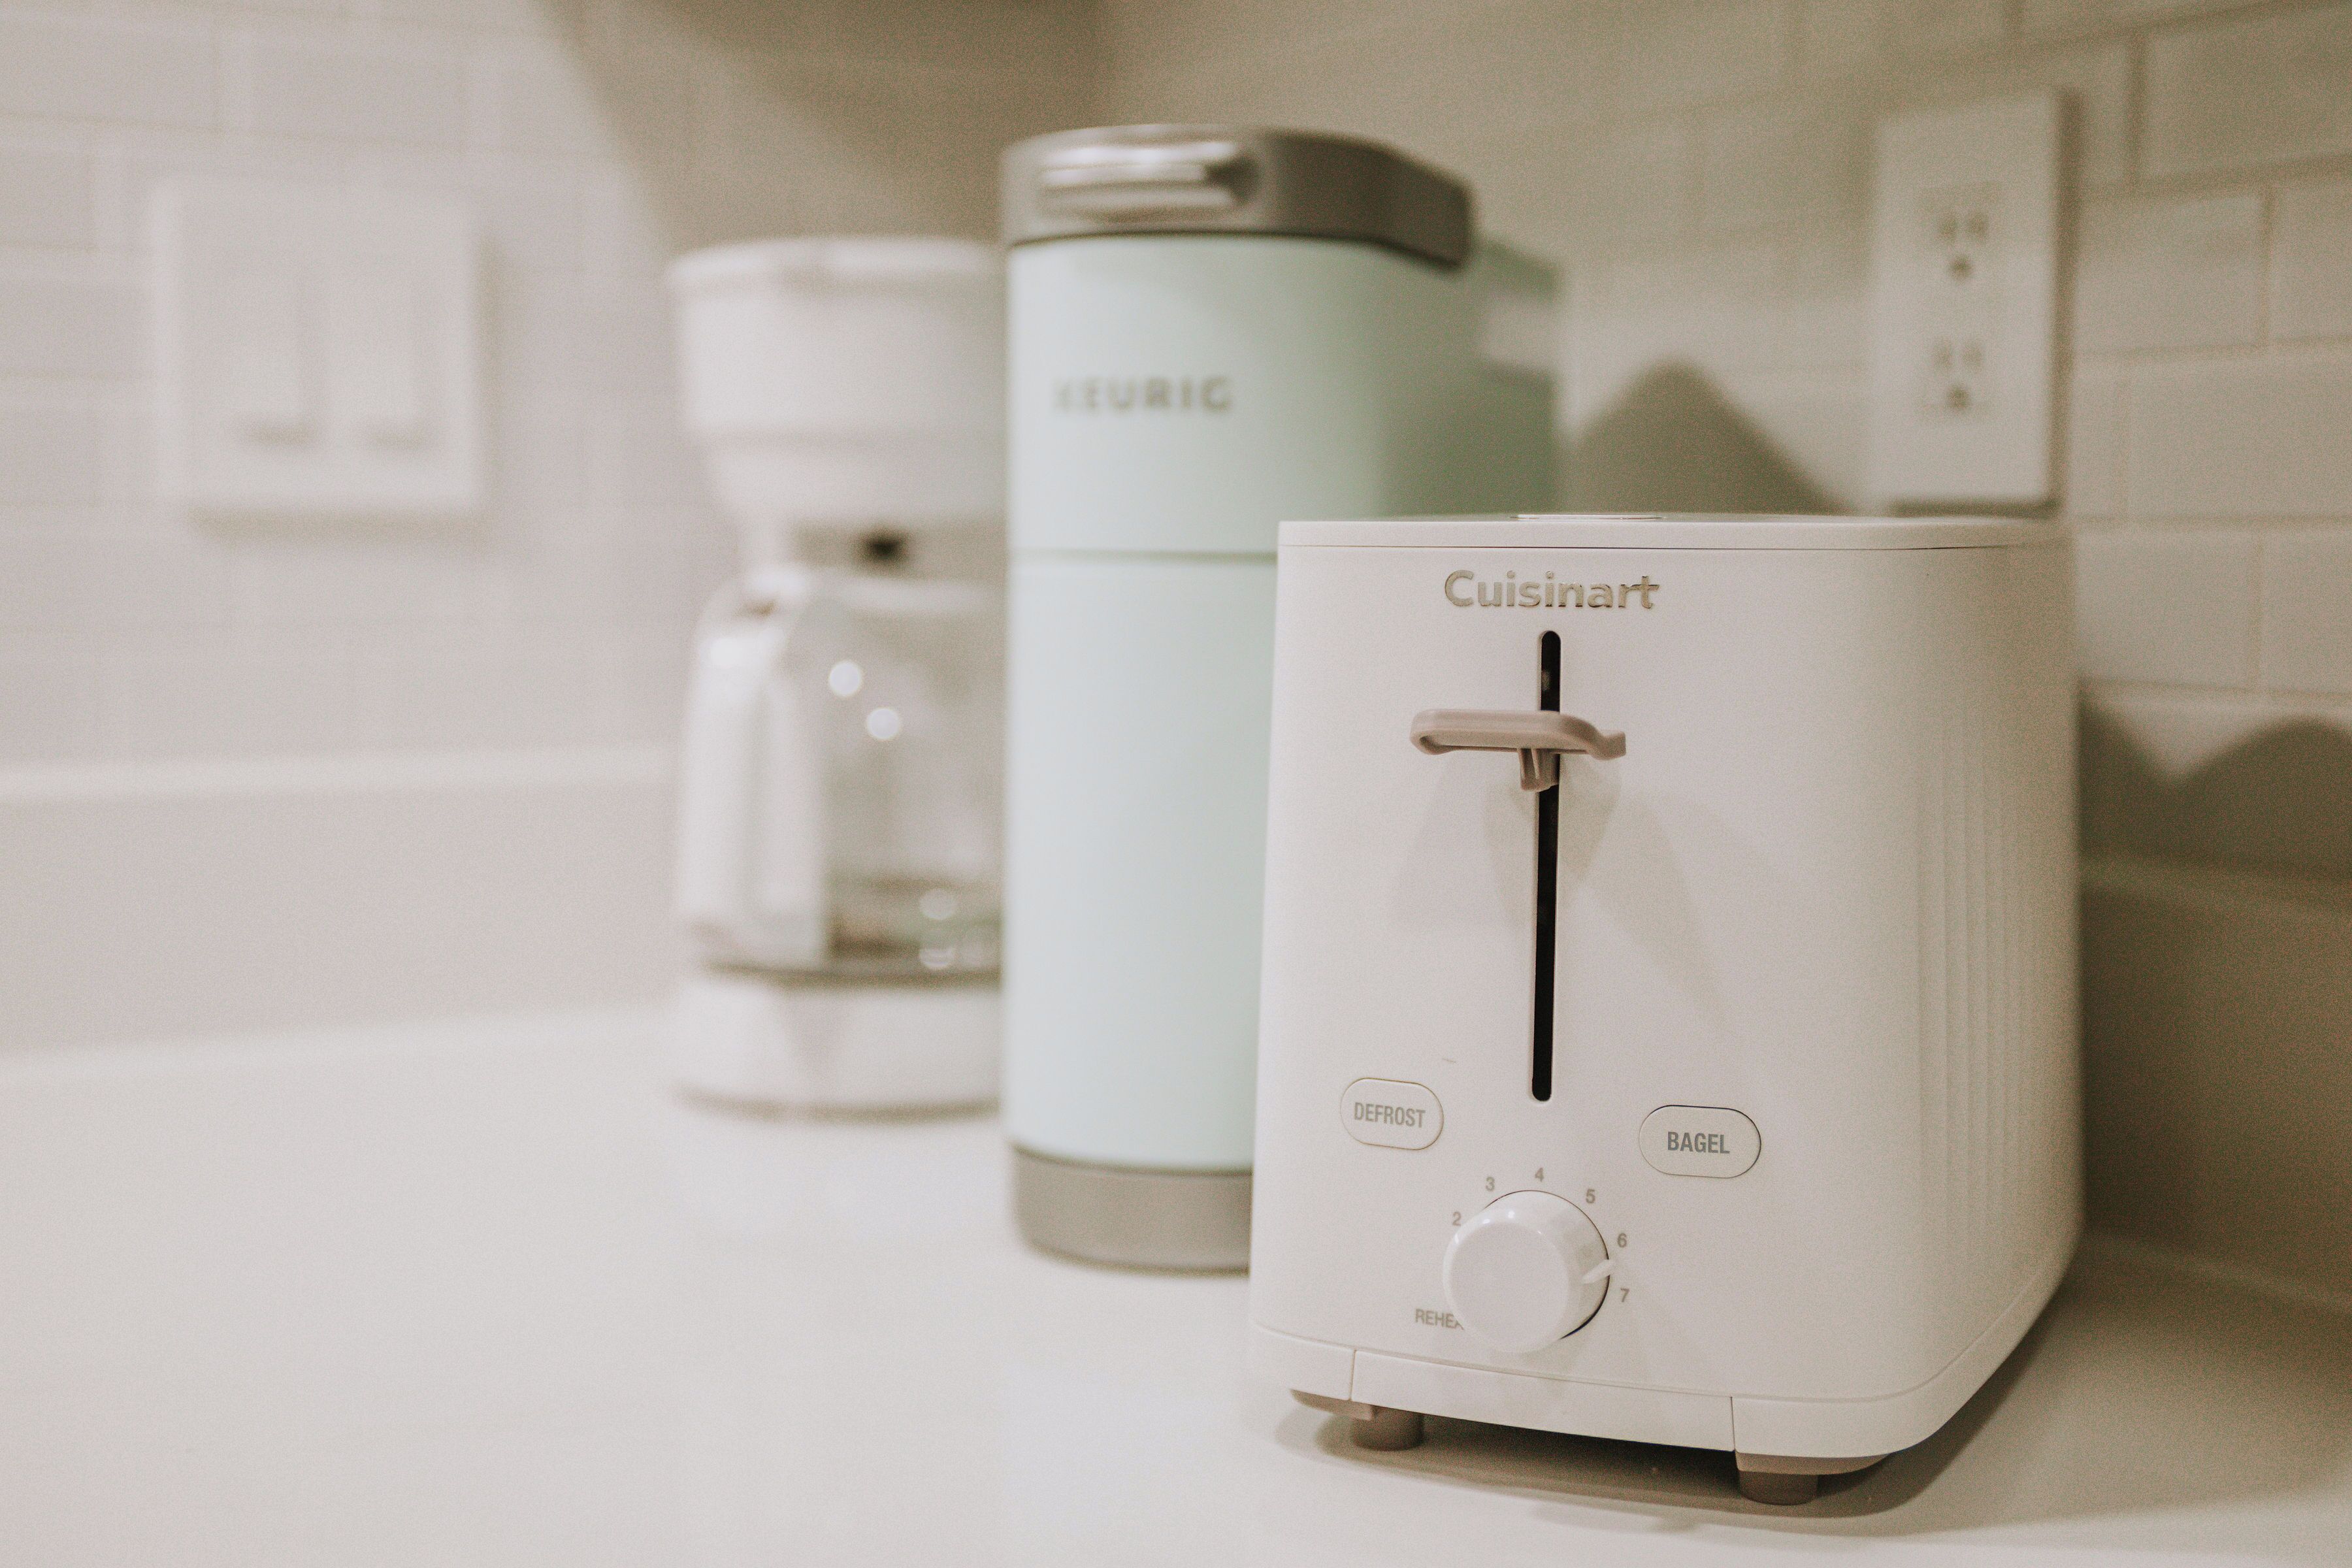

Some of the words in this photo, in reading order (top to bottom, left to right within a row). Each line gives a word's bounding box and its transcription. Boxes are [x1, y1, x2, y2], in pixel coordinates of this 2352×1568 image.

[1053, 374, 1233, 413] KEURIG
[1445, 569, 1660, 609] Cuisinart
[1354, 1102, 1426, 1128] DEFROST
[1667, 1131, 1730, 1154] BAGEL
[1535, 1167, 1544, 1182] 4
[1485, 1176, 1495, 1192] 3
[1586, 1188, 1595, 1203] 5
[1452, 1211, 1462, 1226] 2
[1617, 1233, 1627, 1248] 6
[1620, 1288, 1630, 1303] 7
